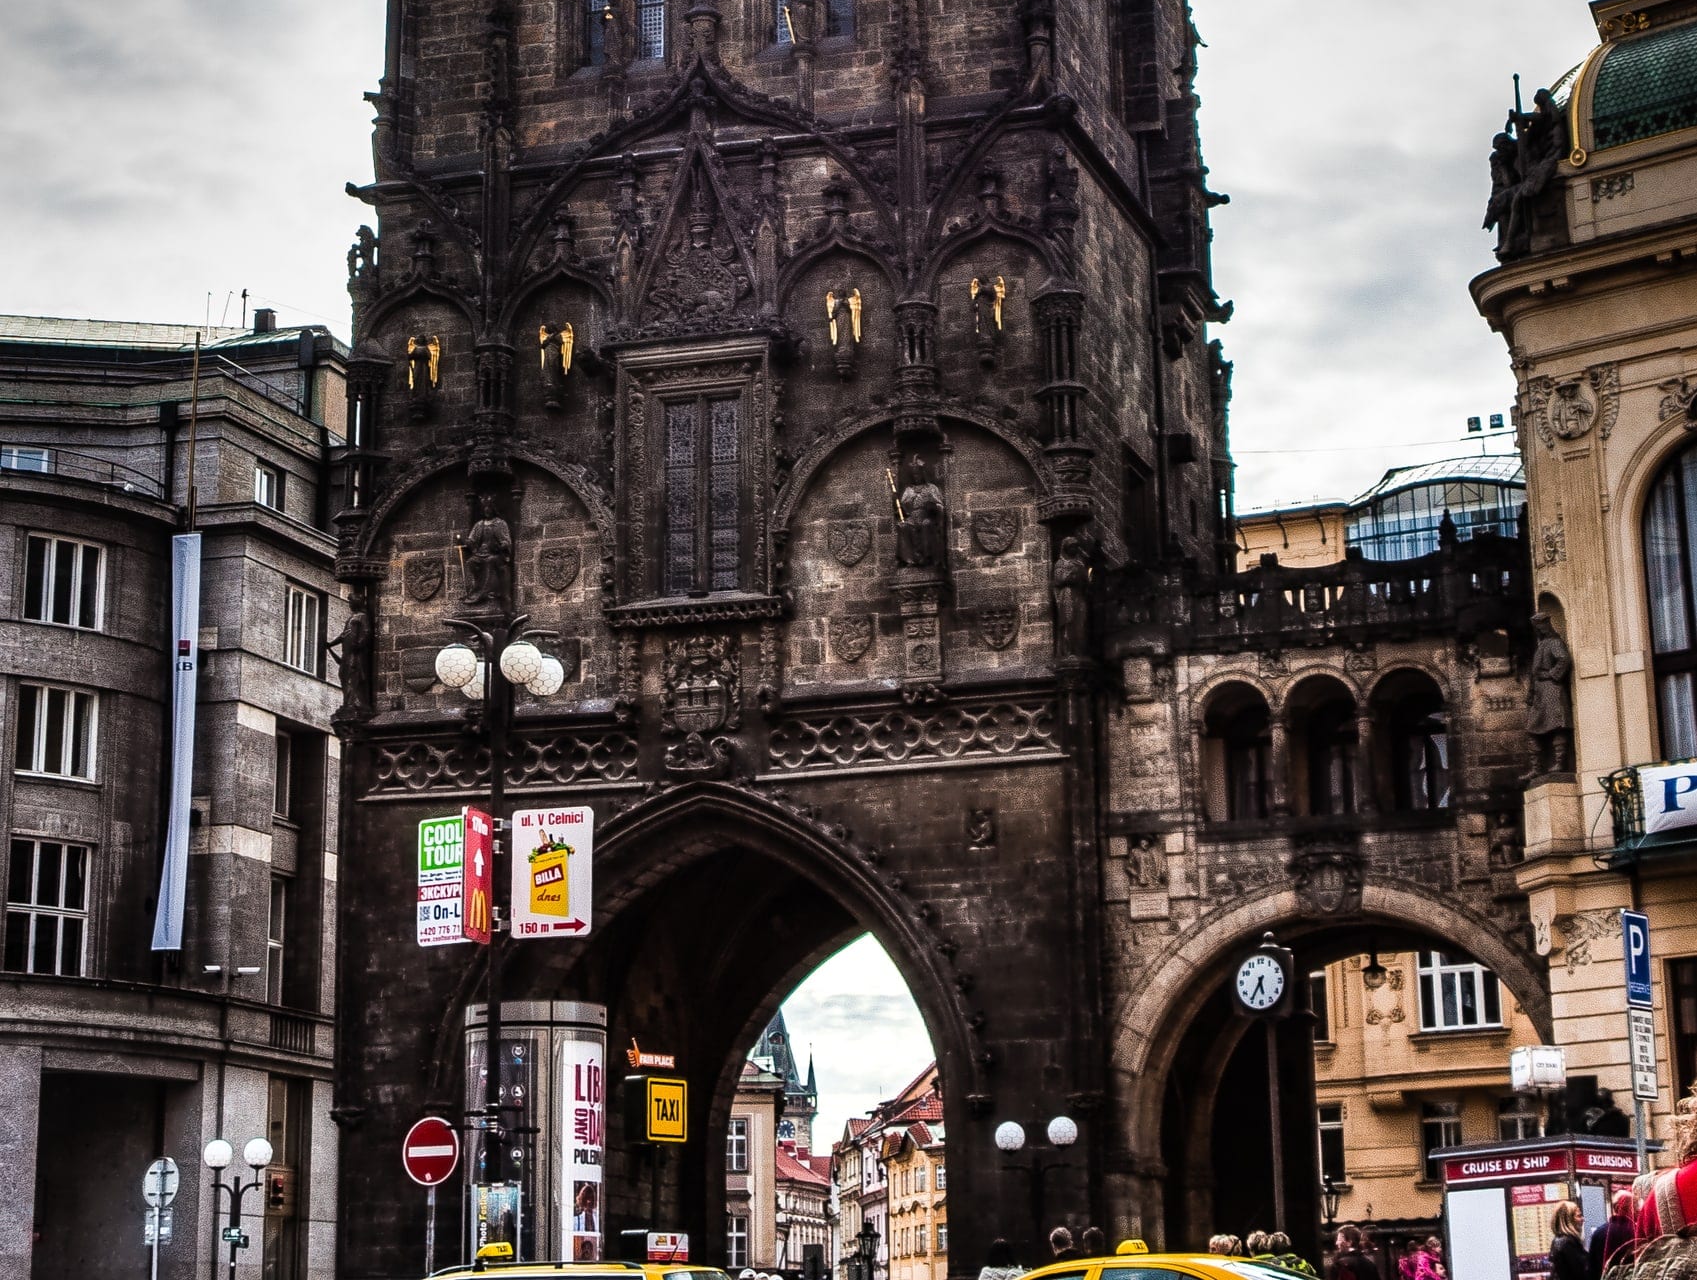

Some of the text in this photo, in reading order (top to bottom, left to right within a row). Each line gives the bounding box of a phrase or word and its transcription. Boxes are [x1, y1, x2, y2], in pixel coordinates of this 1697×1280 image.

[521, 811, 584, 827] ul. V Celnici
[423, 823, 462, 847] COOL
[535, 867, 562, 885] BILLA
[420, 884, 461, 901] ЭКСКУР
[537, 889, 561, 901] dnes
[420, 927, 436, 936] +420
[519, 922, 549, 934] 150 m
[1629, 924, 1644, 975] P
[639, 1053, 675, 1068] FAIR PLACE
[575, 1058, 603, 1104] LÍB
[655, 1098, 680, 1122] TAXI
[574, 1108, 588, 1145] JAKO
[1462, 1155, 1550, 1175] CRUISE BY SHIP
[1588, 1154, 1633, 1168] EXCURSIONS
[480, 1222, 488, 1247] Photo
